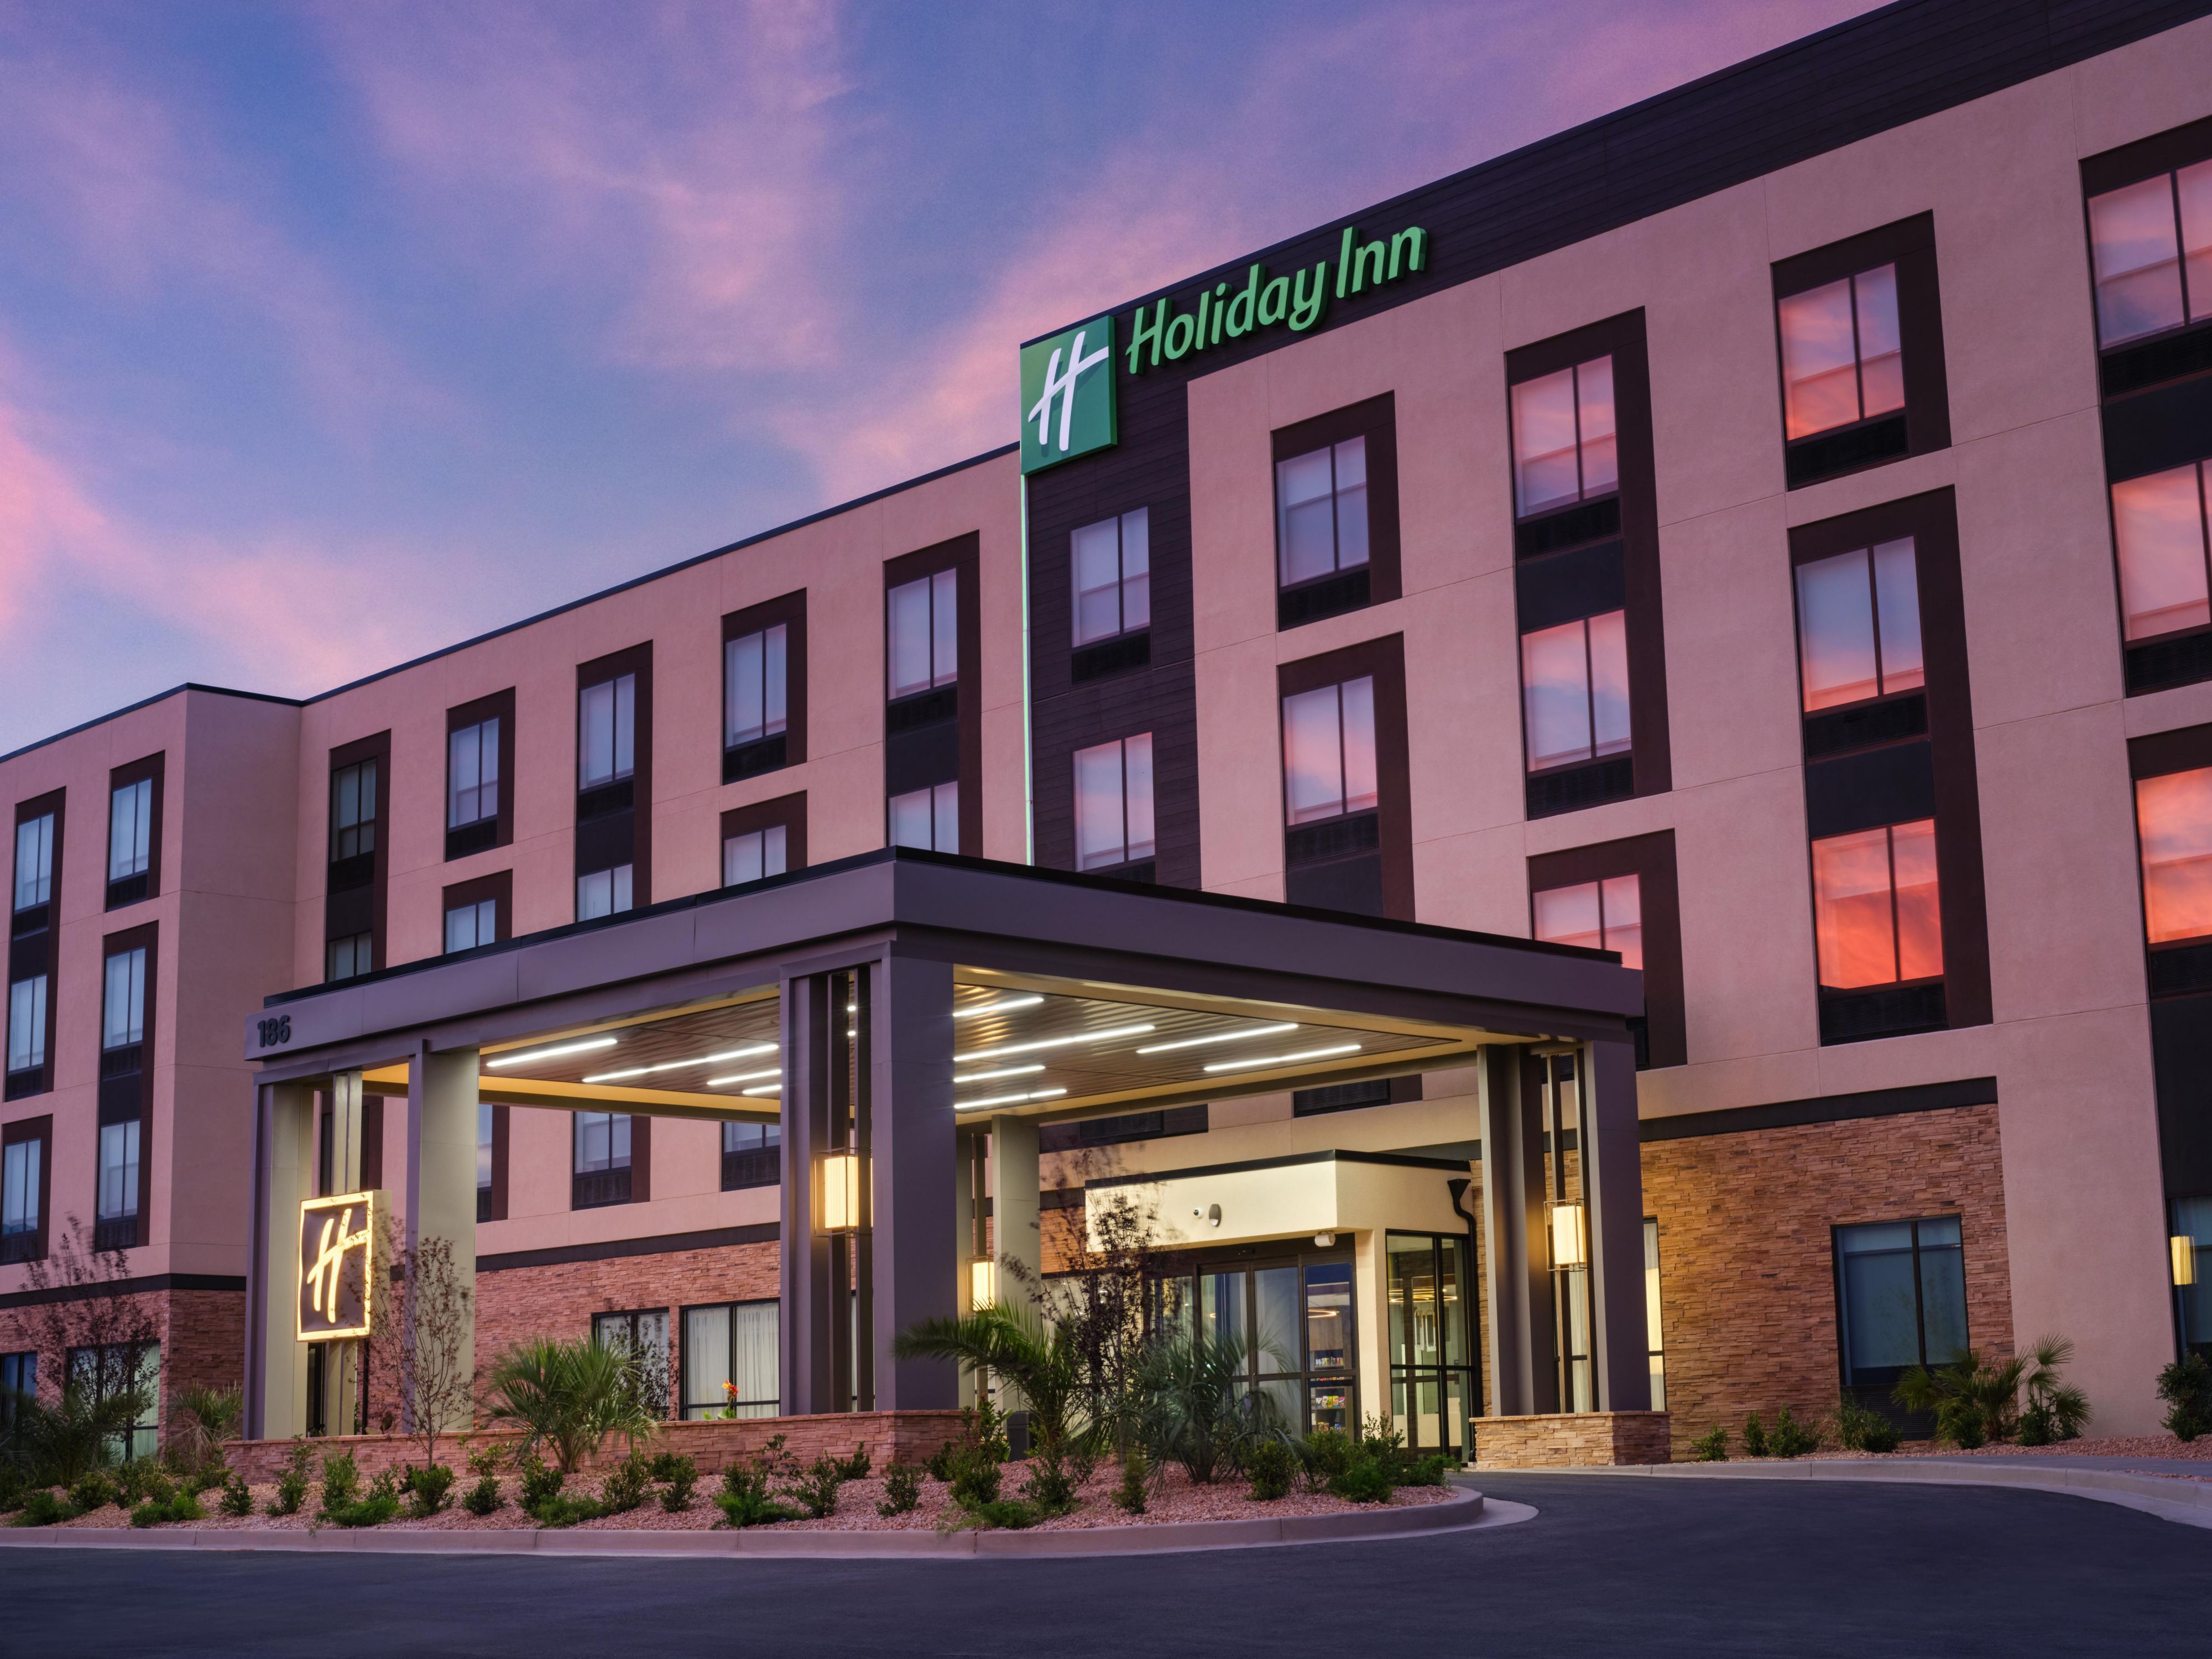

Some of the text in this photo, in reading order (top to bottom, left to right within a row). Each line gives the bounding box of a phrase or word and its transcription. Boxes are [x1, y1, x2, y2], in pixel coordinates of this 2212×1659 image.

[1126, 226, 1428, 375] Holiday Inn
[1028, 331, 1109, 452] H
[257, 1015, 290, 1048] 186
[307, 1208, 369, 1323] H
